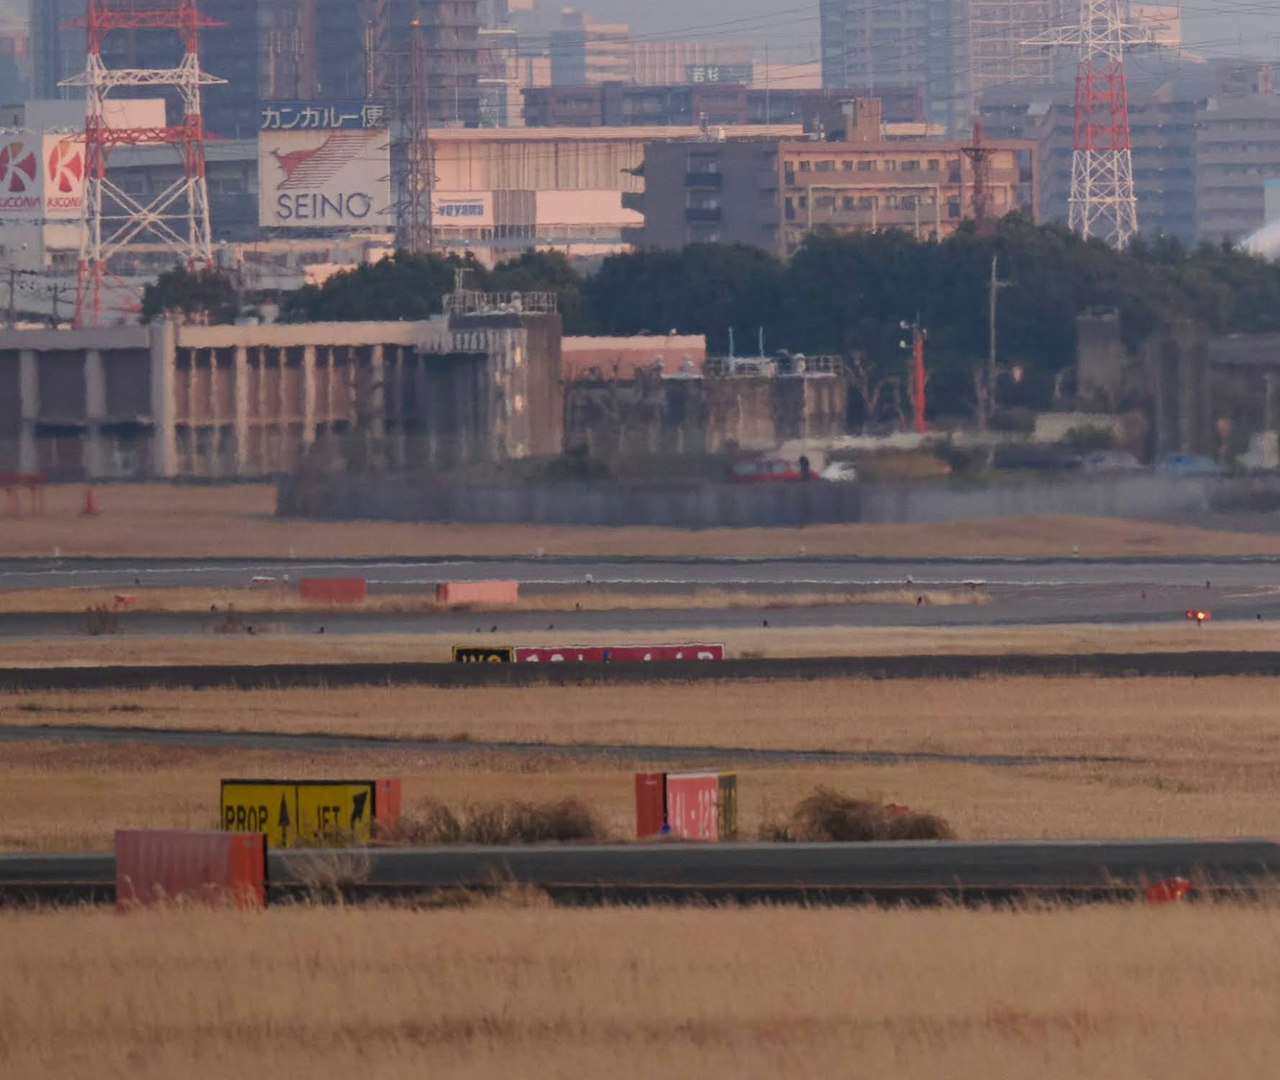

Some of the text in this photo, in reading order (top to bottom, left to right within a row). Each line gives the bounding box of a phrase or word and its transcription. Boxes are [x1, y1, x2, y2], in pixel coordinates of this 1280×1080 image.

[261, 106, 384, 129] カンガルー便
[277, 193, 371, 219] SEINO
[225, 805, 268, 831] PROP
[314, 804, 341, 838] JET
